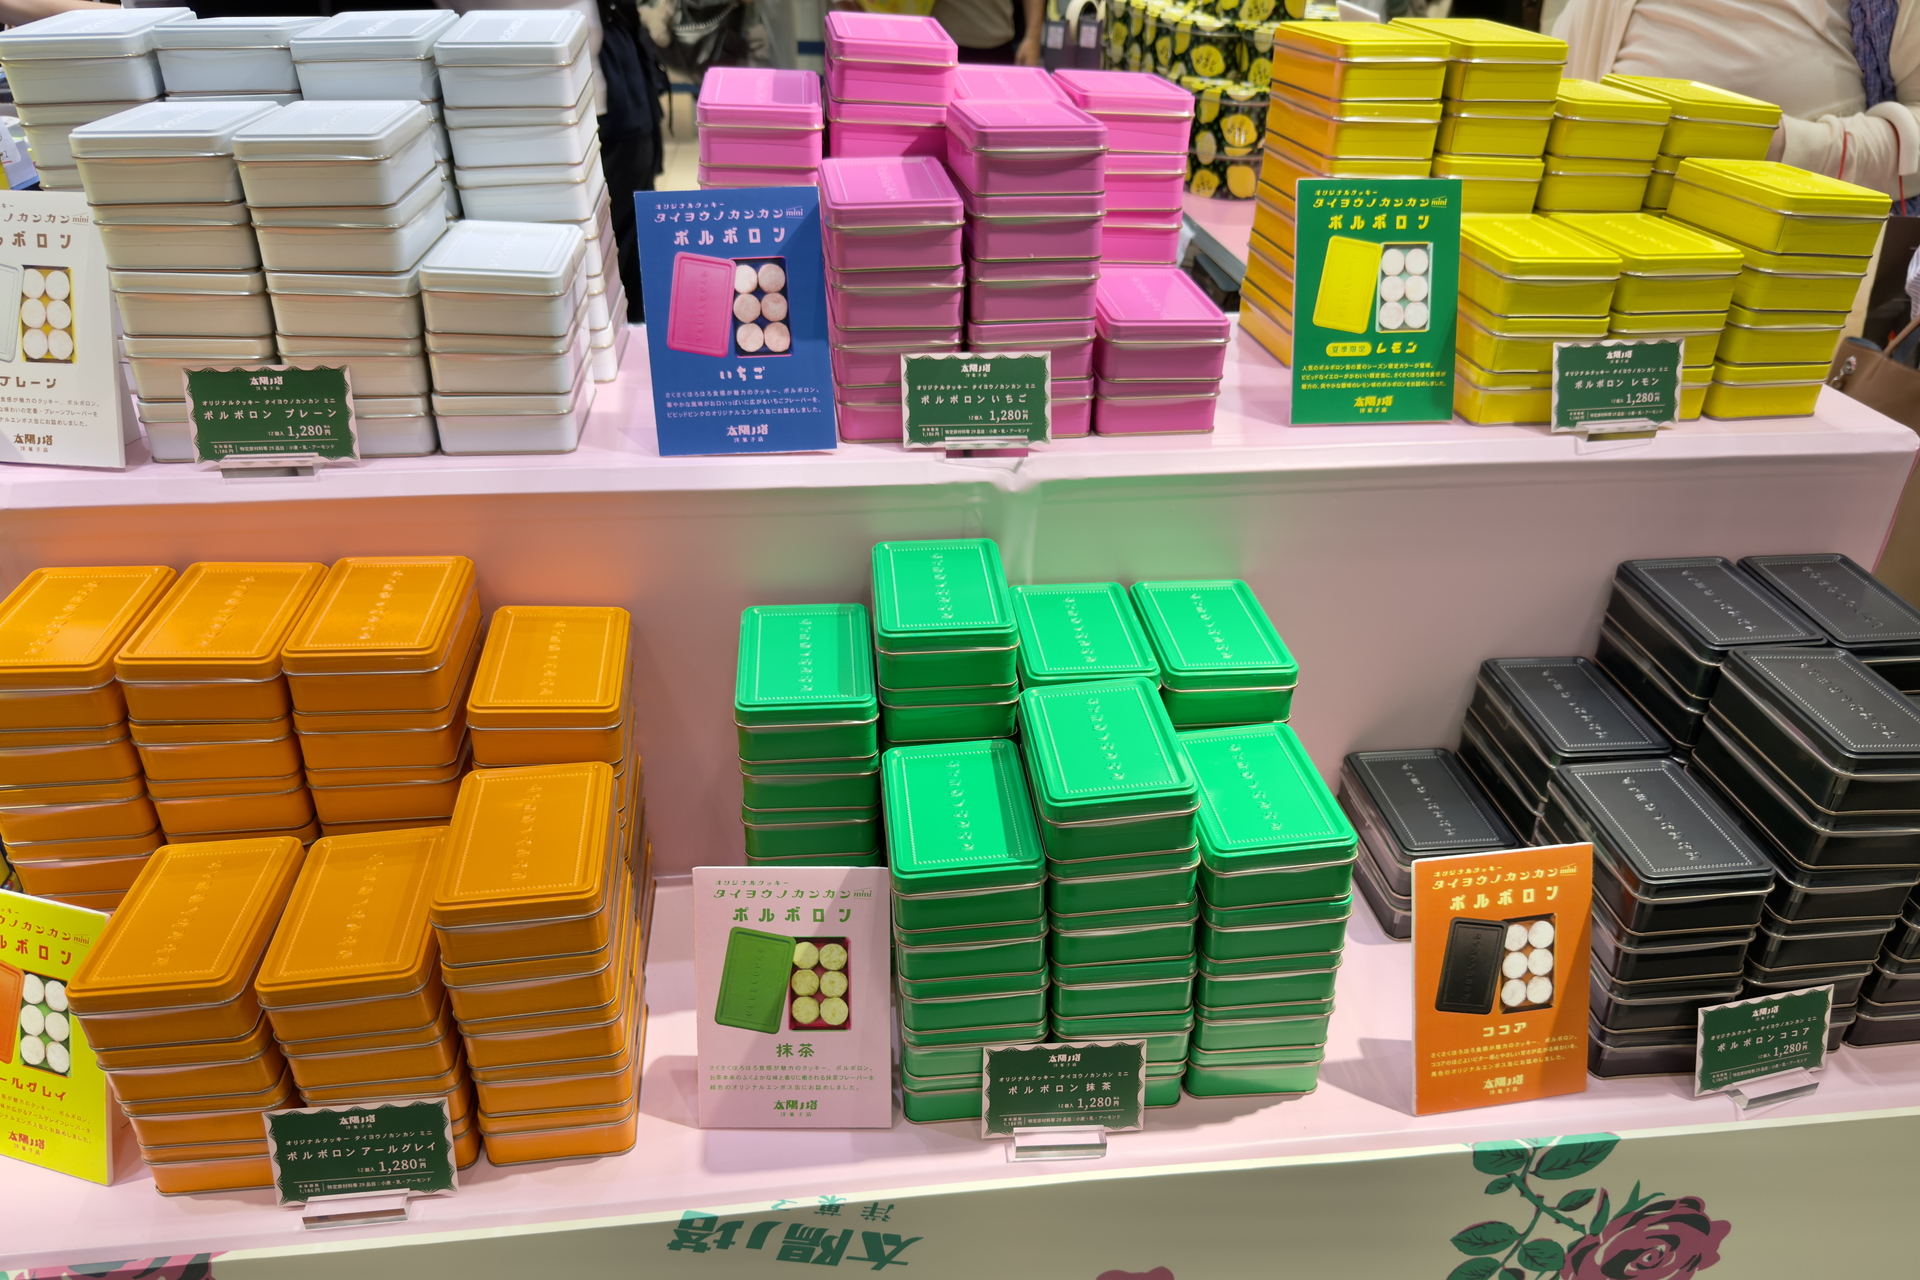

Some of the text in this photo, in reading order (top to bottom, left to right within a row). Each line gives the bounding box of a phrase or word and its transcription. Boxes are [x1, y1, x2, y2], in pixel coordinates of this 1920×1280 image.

[655, 202, 725, 210] オリジナルクッキー
[1312, 197, 1447, 208] タイヨウノカンカン mini
[72, 215, 89, 223] mini
[654, 209, 804, 223] タイヨウノカンカン mini
[1328, 213, 1430, 230] ポルボロン
[0, 231, 71, 249] ボロン
[674, 227, 786, 246] ポルボロン
[1376, 342, 1418, 354] レモン
[719, 366, 765, 381] いちご
[961, 363, 991, 373] 太陽ノ塔
[250, 376, 283, 386] 太陽ノ塔
[1574, 378, 1659, 390] ポルボロン レモン
[202, 399, 260, 407] オリジナルクッキー
[1353, 395, 1394, 407] 太陽ノ塔
[204, 408, 337, 421] ポルボロン プレーン
[726, 424, 769, 436] 太陽ノ塔
[13, 433, 53, 446] 太陽ノ塔
[1434, 866, 1502, 877] オリジナルクッキー
[1432, 866, 1577, 890] タイヨウノカンカン mini
[713, 889, 872, 899] タイヨウノカンカン mini
[1449, 886, 1558, 911] ポルボロン
[732, 906, 851, 923] ポルボロン
[73, 936, 90, 945] mini
[1483, 1022, 1527, 1037] ココア
[776, 1043, 815, 1058] 抹茶
[1048, 1053, 1081, 1063] 太陽ノ塔
[999, 1075, 1055, 1083] オリジナルクッキー
[1060, 1072, 1113, 1080] タイヨウノカンカン
[1483, 1074, 1524, 1090] 太陽ノ塔
[773, 1100, 818, 1111] 太陽ノ塔
[339, 1114, 376, 1125] 太陽ノ塔
[8, 1131, 45, 1150] 太陽ノ塔
[286, 1136, 350, 1146] オリジナルクッキー
[355, 1131, 415, 1141] タイヨウノカンカン
[666, 1209, 924, 1271] 太陽ノ塔
